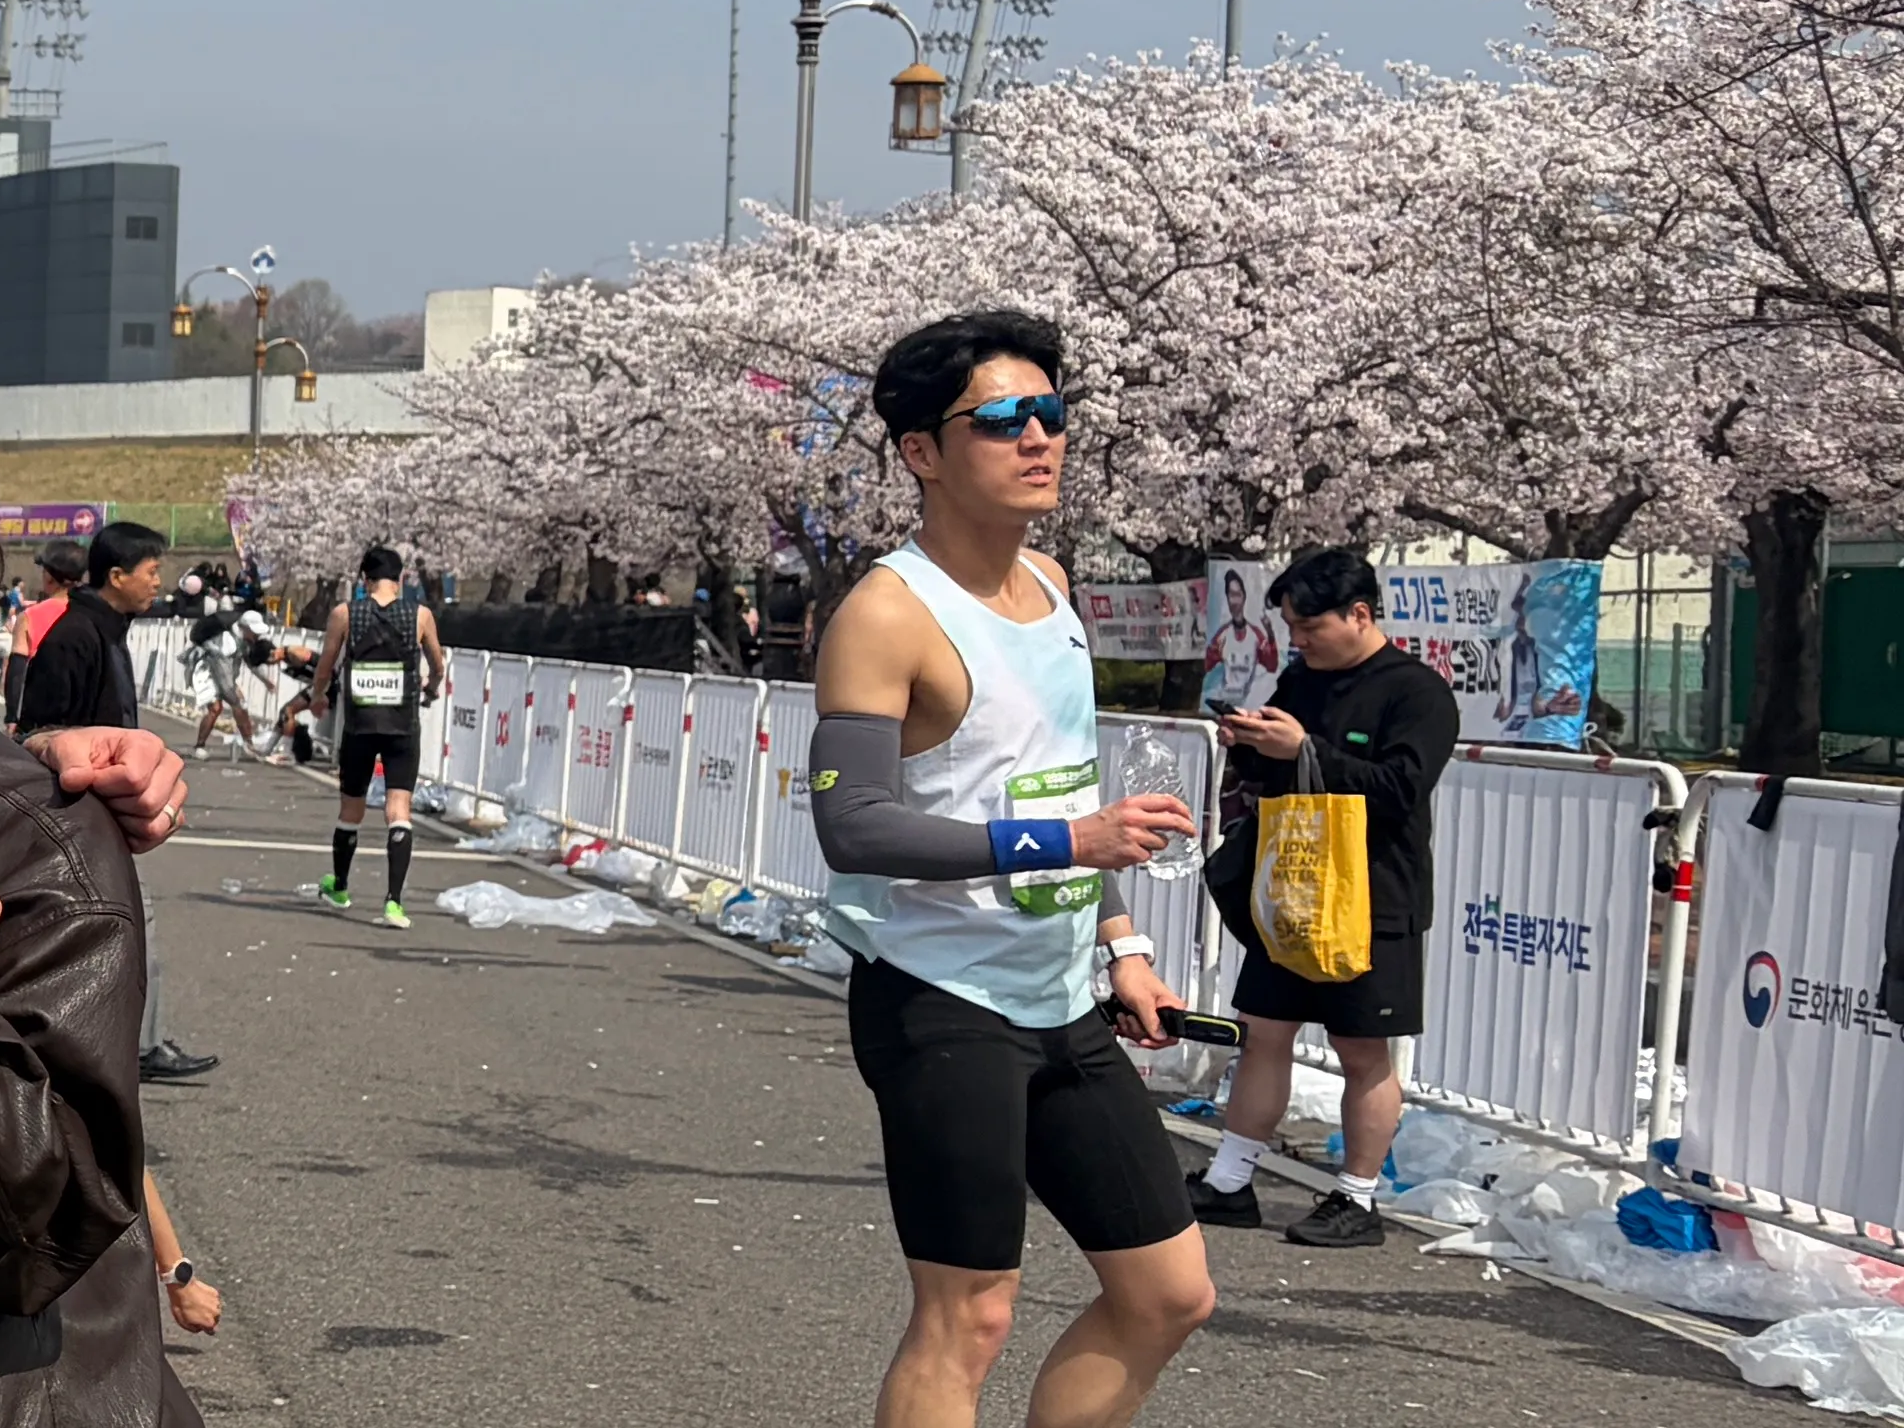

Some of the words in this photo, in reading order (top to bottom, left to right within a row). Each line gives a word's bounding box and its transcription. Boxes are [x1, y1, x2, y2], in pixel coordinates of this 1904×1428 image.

[1389, 576, 1450, 624] 고기곤
[1454, 587, 1501, 625] 회원님의
[1463, 892, 1592, 975] 전북특별자치도
